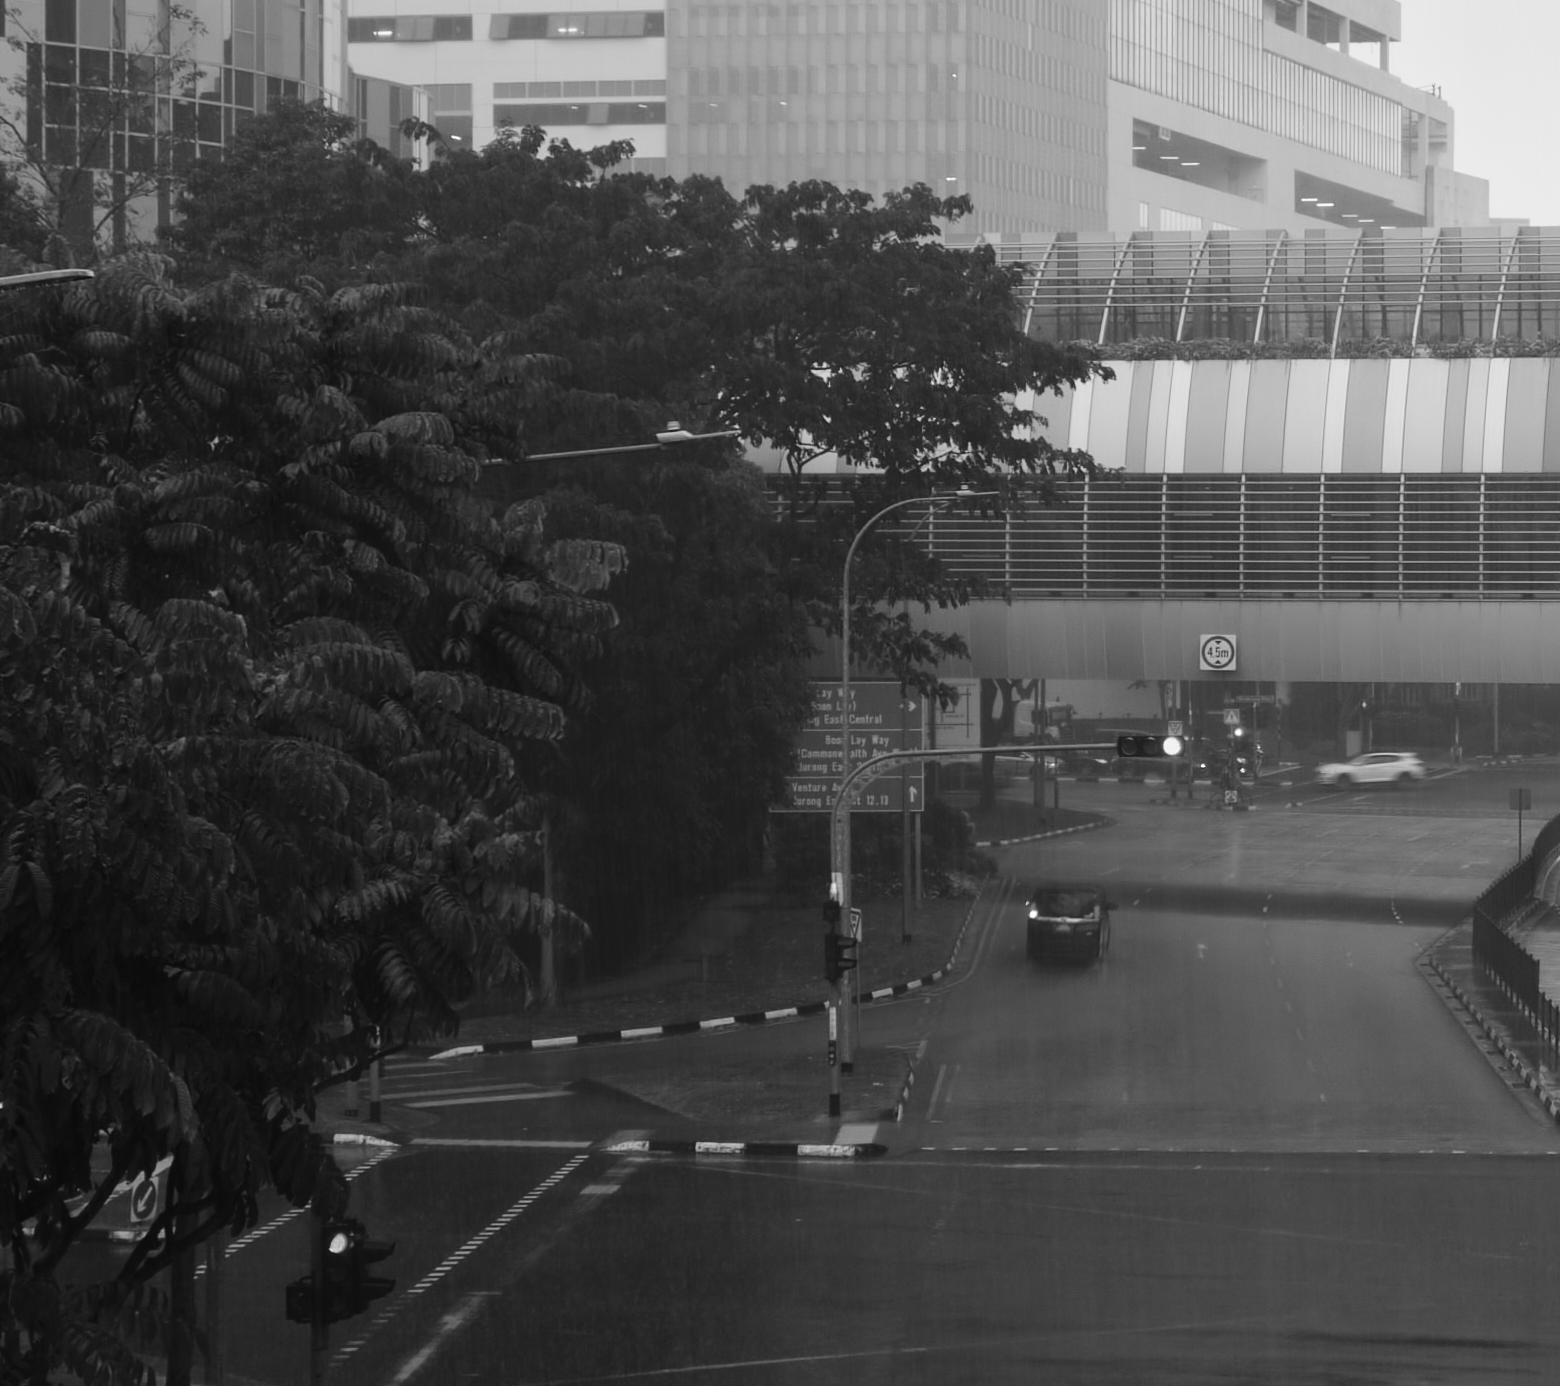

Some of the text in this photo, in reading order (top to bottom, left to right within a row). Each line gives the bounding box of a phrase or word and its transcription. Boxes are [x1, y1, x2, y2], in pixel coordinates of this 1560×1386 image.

[1207, 646, 1229, 659] 4.5m
[848, 714, 883, 725] Central
[850, 734, 866, 747] Lay
[872, 734, 890, 748] Way
[792, 782, 827, 792] Venture
